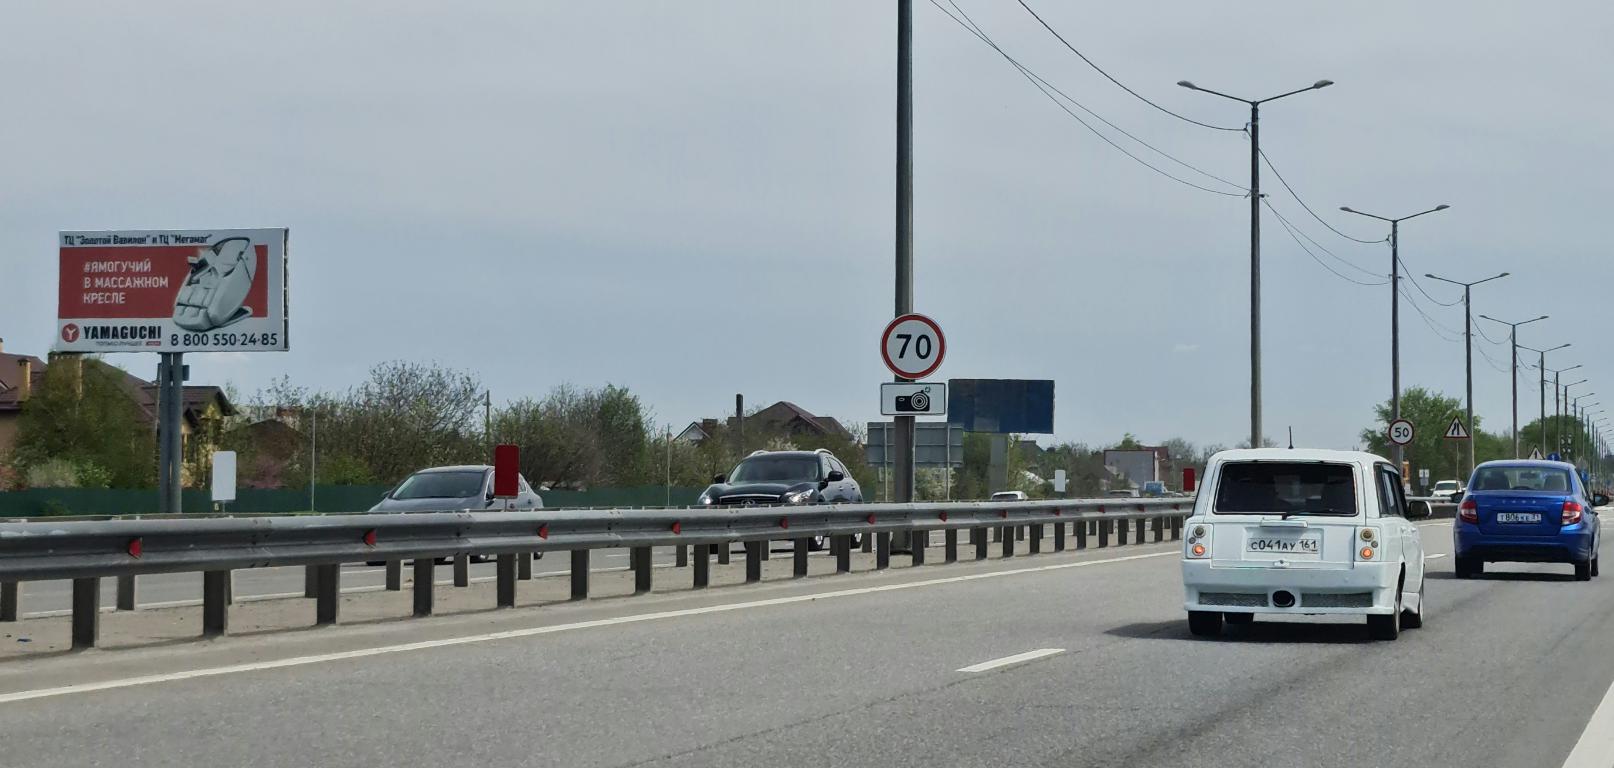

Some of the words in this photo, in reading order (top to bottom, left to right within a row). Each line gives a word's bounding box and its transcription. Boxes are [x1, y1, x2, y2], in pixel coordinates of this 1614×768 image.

[64, 235, 75, 245] ТЦ
[159, 234, 170, 246] ТЦ
[84, 258, 152, 273] #ЯМОГУЧИЙ
[84, 276, 92, 289] В
[95, 276, 169, 289] МАССАЖНОМ
[83, 291, 127, 304] КРЕСЛЕ
[83, 325, 162, 340] YAMAGUCHI
[170, 333, 179, 346] 8
[183, 333, 209, 346] 800
[896, 333, 932, 360] 70
[1394, 427, 1410, 438] 50
[1299, 540, 1317, 549] 161
